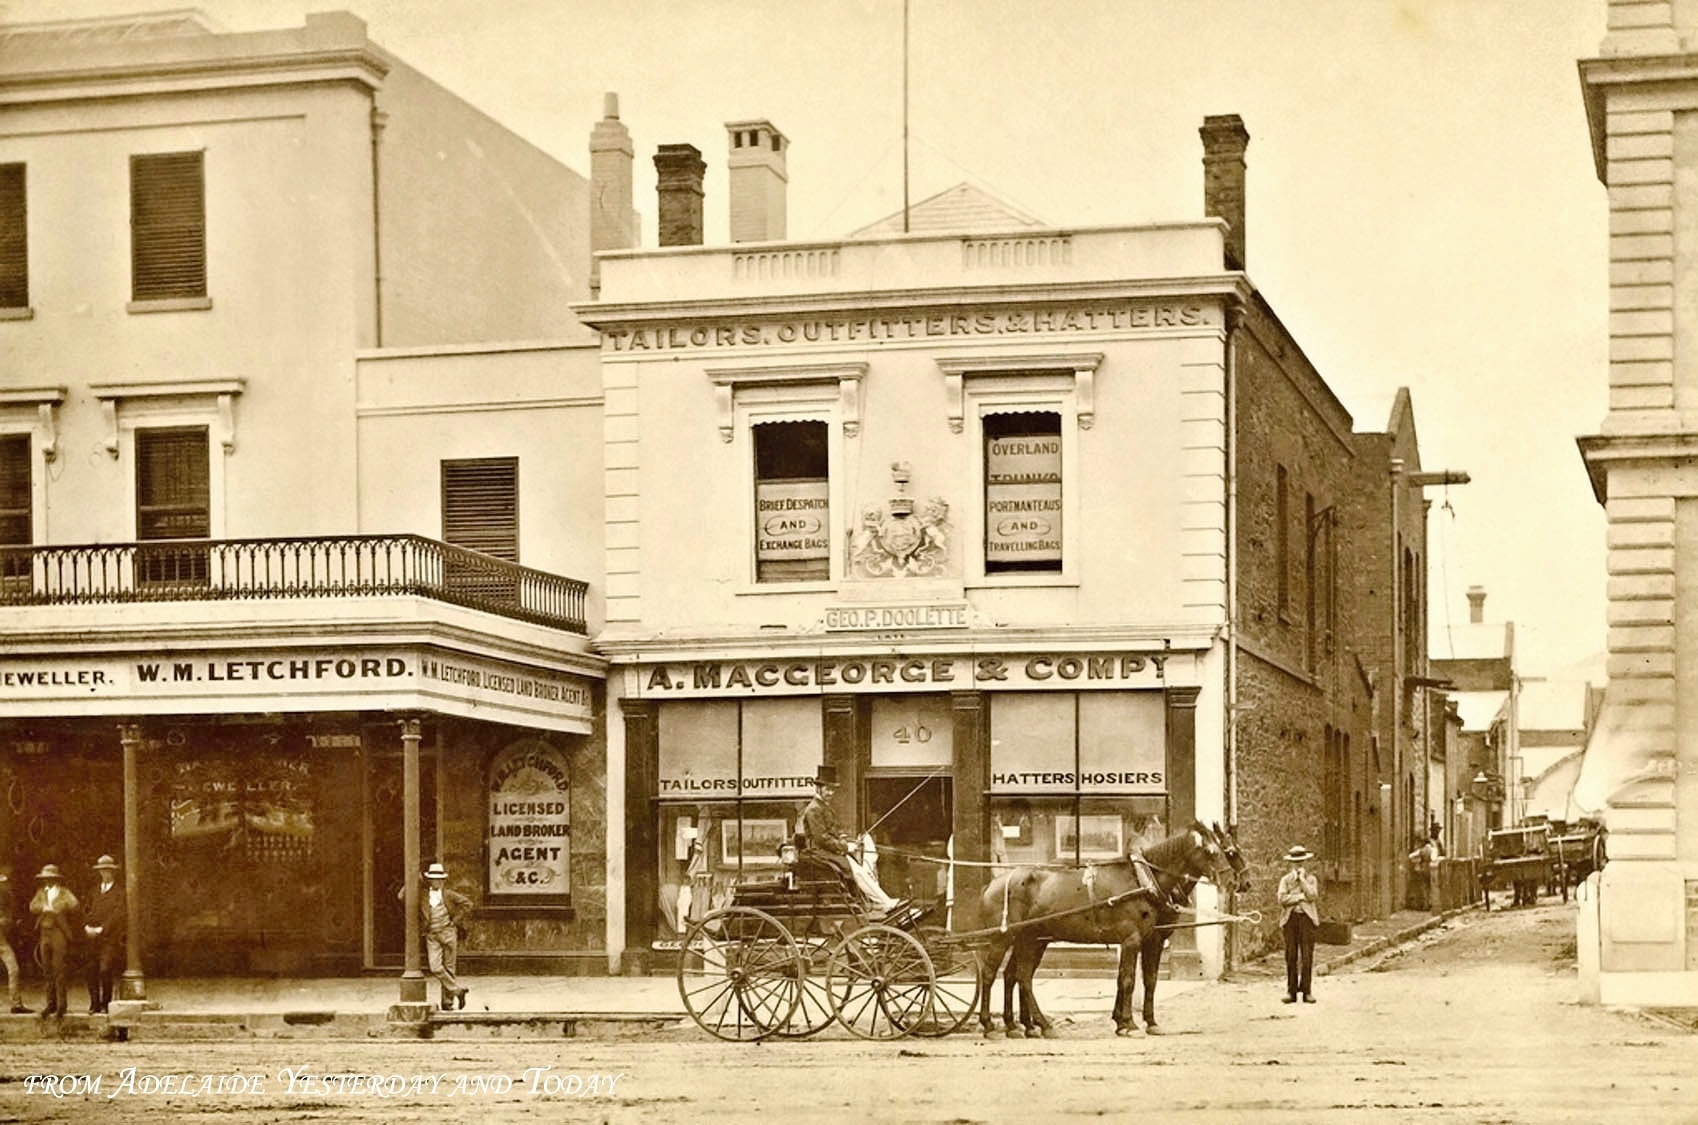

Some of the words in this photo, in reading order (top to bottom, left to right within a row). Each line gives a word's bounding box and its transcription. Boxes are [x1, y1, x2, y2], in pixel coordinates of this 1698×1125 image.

[992, 442, 1059, 456] OVERLAND
[780, 520, 807, 530] AND
[1011, 521, 1039, 531] AND
[760, 539, 803, 551] EXCHANGE
[989, 541, 1037, 553] TRAVELLING
[975, 657, 1009, 682] &
[0, 671, 114, 686] EWELLER.
[892, 726, 933, 744] 40
[660, 779, 738, 791] TAILORS
[993, 773, 1075, 785] HATTERS
[1081, 772, 1163, 785] HOSIERS
[493, 803, 565, 815] LICENSED
[490, 824, 522, 838] LAND
[523, 824, 571, 838] BROKER
[498, 847, 561, 861] AGENT
